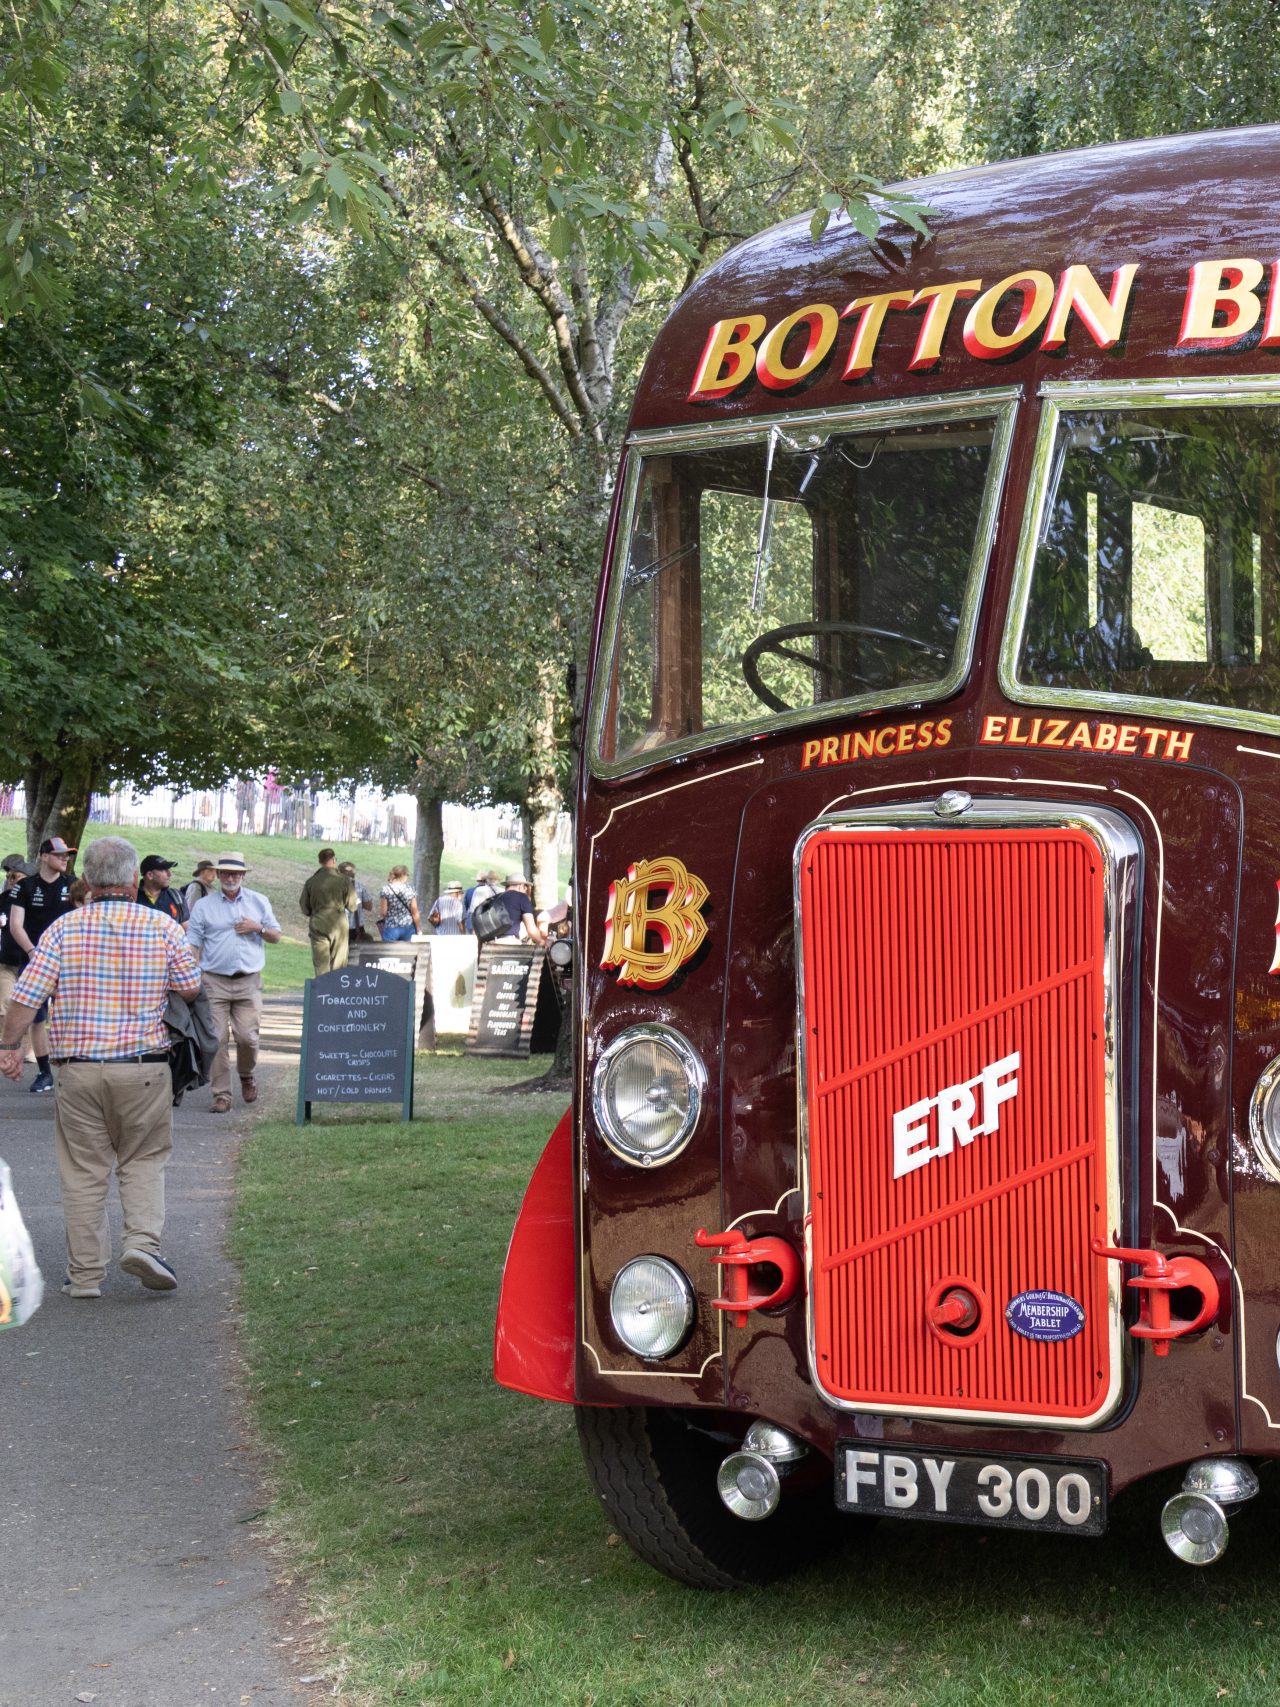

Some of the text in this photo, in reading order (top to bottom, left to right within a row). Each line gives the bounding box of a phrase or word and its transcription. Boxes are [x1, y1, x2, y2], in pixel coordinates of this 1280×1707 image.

[687, 264, 1140, 403] BOTTON
[801, 716, 1195, 771] PRINCESS ELIZABETH
[340, 974, 350, 989] S
[366, 974, 379, 988] W
[317, 993, 389, 1006] TOBACCONIST
[496, 991, 516, 1001] COFFEE
[347, 1009, 367, 1019] AND
[488, 1010, 517, 1019] CHOCOLATE
[317, 1022, 387, 1033] CONFECTIONERY
[359, 1049, 398, 1059] CHOCOLATE
[315, 1072, 362, 1081] CIGARETTES
[364, 1086, 392, 1095] DRINKS
[893, 1050, 1021, 1180] ERF
[1018, 1302, 1070, 1317] MEMBERSHIP
[1029, 1317, 1061, 1328] TABLET
[846, 1450, 1091, 1526] FBY 300
